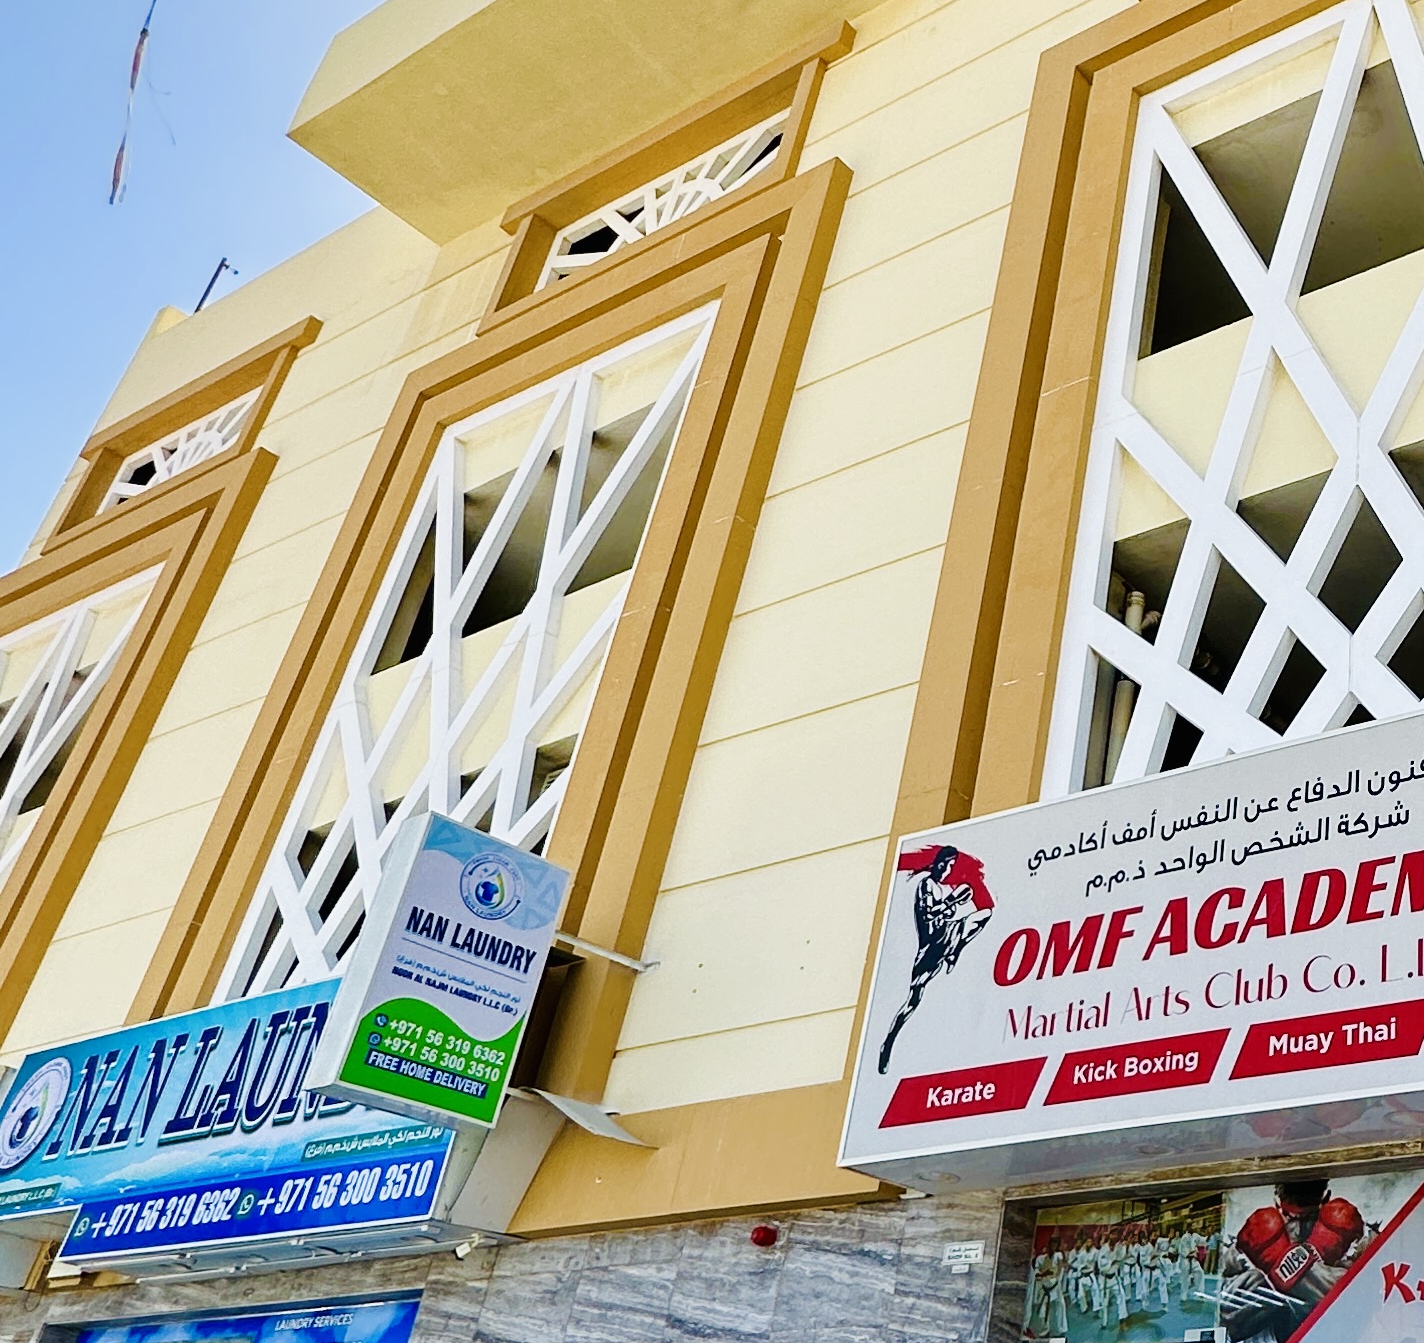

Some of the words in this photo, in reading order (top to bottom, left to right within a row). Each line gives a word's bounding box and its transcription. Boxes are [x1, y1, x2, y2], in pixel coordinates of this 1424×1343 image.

[1243, 792, 1279, 822] عن
[1286, 769, 1360, 811] الدفاع
[1111, 810, 1156, 844] أمف
[1160, 796, 1238, 841] النفس
[1230, 816, 1330, 865] الشخص
[1336, 800, 1410, 836] شركة
[1153, 839, 1224, 878] الواحد
[405, 906, 450, 944] NAN
[450, 922, 537, 975] LAUNDRY
[992, 906, 1144, 988] OMF
[414, 972, 423, 984] AL
[1002, 990, 1111, 1043] Martial
[1120, 986, 1190, 1023] Arts
[1204, 963, 1289, 1010] Club
[1303, 954, 1366, 994] Co.
[383, 1036, 418, 1057] +971
[420, 1046, 438, 1063] 56
[440, 1053, 465, 1071] 300
[467, 1063, 500, 1082] 3510
[390, 1018, 423, 1040] +971
[425, 1029, 444, 1047] 56
[446, 1035, 471, 1056] 319
[473, 1044, 505, 1065] 6362
[1268, 1030, 1334, 1056] Muay
[1342, 1018, 1397, 1047] Thai
[42, 1033, 189, 1161] NAN
[158, 1001, 352, 1144] LAUN
[368, 1050, 398, 1070] FREE
[400, 1060, 433, 1082] HOME
[433, 1069, 487, 1096] DELIVERY
[1072, 1060, 1117, 1085] Kick
[1123, 1050, 1199, 1078] Boxing
[926, 1081, 996, 1108] Karate
[257, 1176, 315, 1216] +971
[312, 1172, 342, 1210] 56
[339, 1167, 382, 1207] 300
[380, 1159, 434, 1202] 3510
[91, 1201, 140, 1239] +971
[136, 1198, 161, 1234] 56
[158, 1194, 197, 1230] 319
[192, 1187, 241, 1225] 6362
[274, 1316, 314, 1332] LAUNDRY
[313, 1313, 354, 1328] SERVICES
